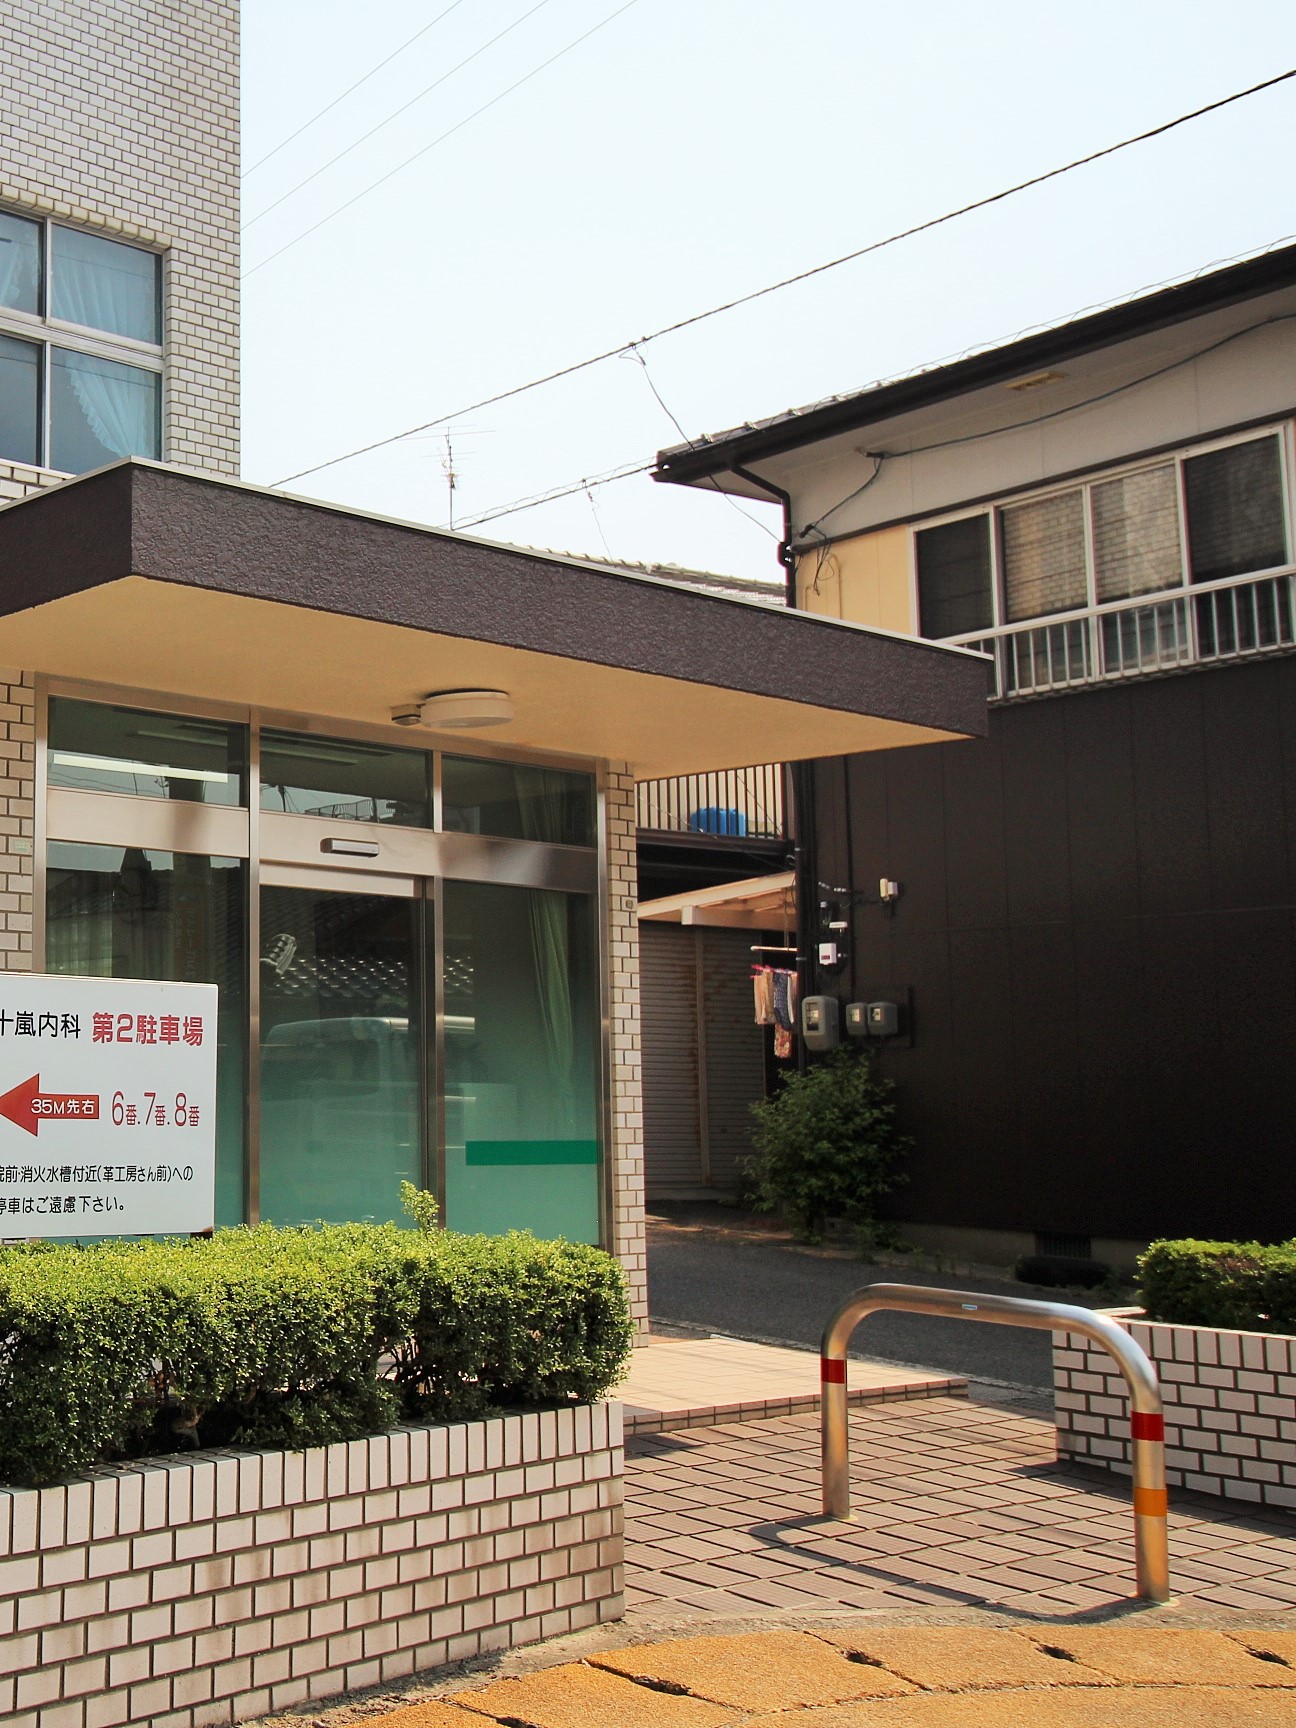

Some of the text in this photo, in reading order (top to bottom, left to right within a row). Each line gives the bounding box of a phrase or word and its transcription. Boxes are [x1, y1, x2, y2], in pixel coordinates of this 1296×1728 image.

[92, 1012, 203, 1046] 第2駐車場
[30, 1098, 95, 1115] 35M先右
